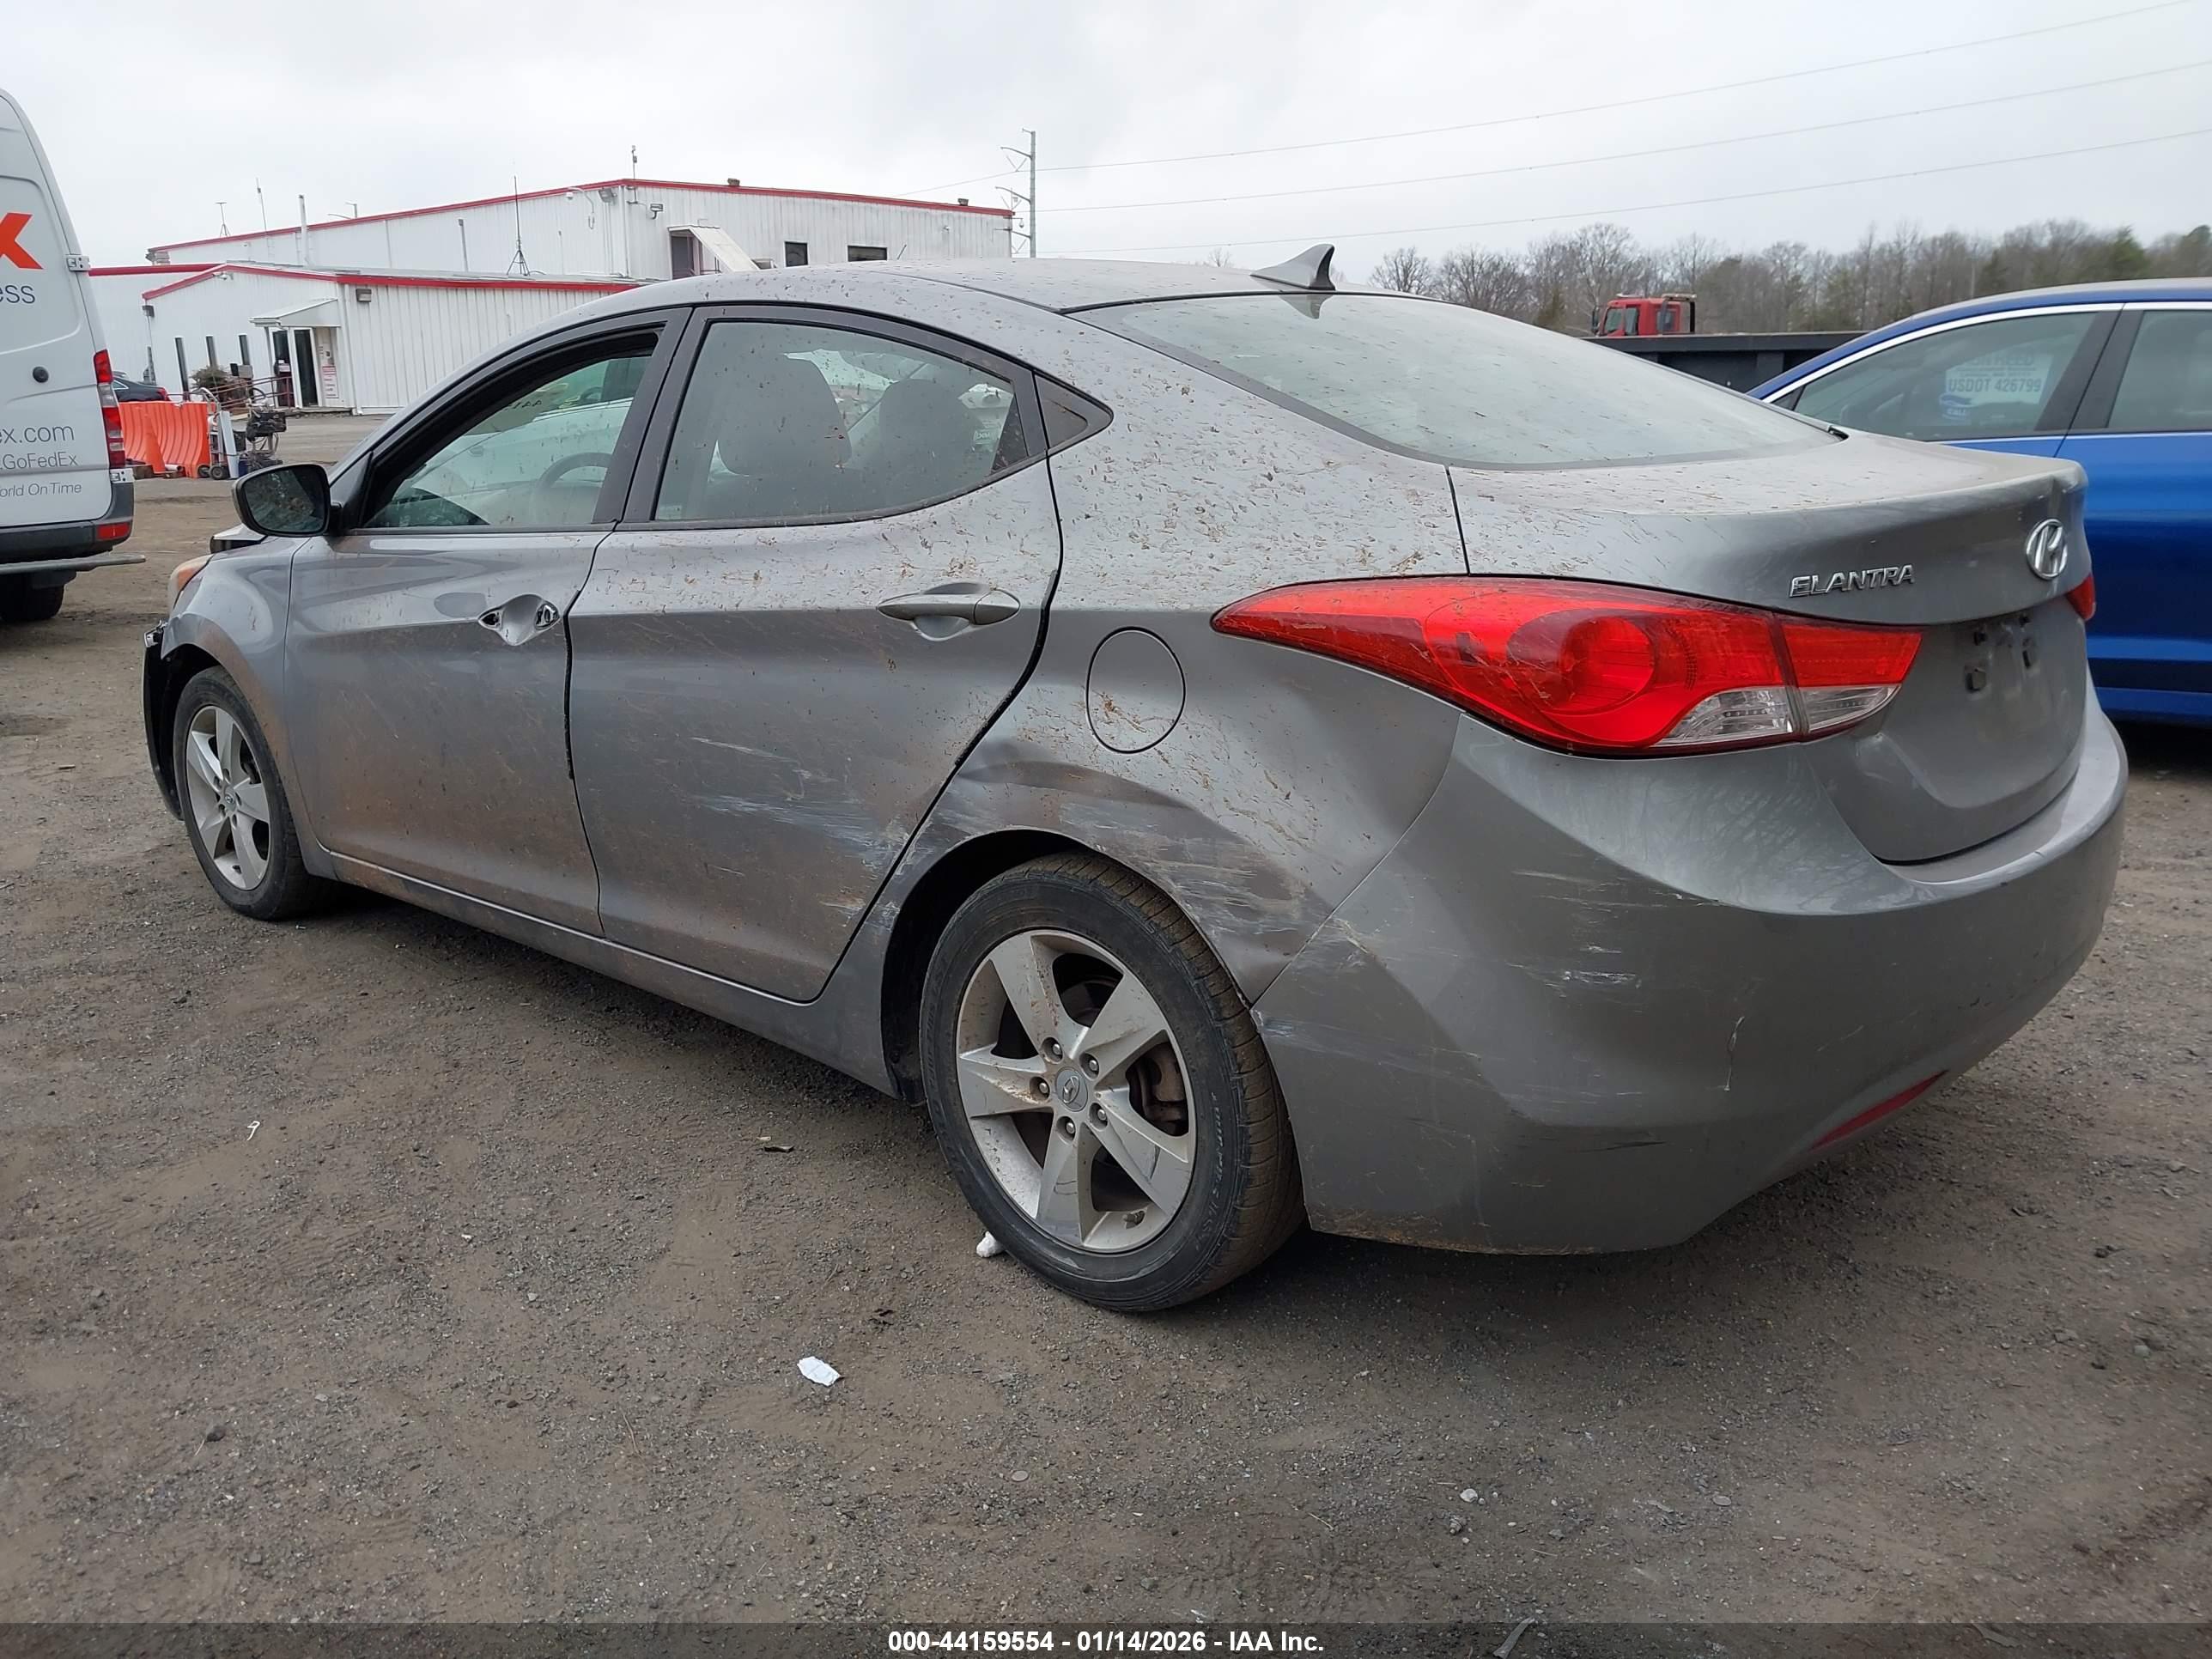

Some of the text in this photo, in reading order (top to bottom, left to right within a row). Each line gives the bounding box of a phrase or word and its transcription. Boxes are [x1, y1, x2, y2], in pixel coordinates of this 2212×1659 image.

[1948, 378, 1992, 392] USDOT
[50, 482, 82, 495] Time
[1789, 563, 1916, 598] ELANTRA
